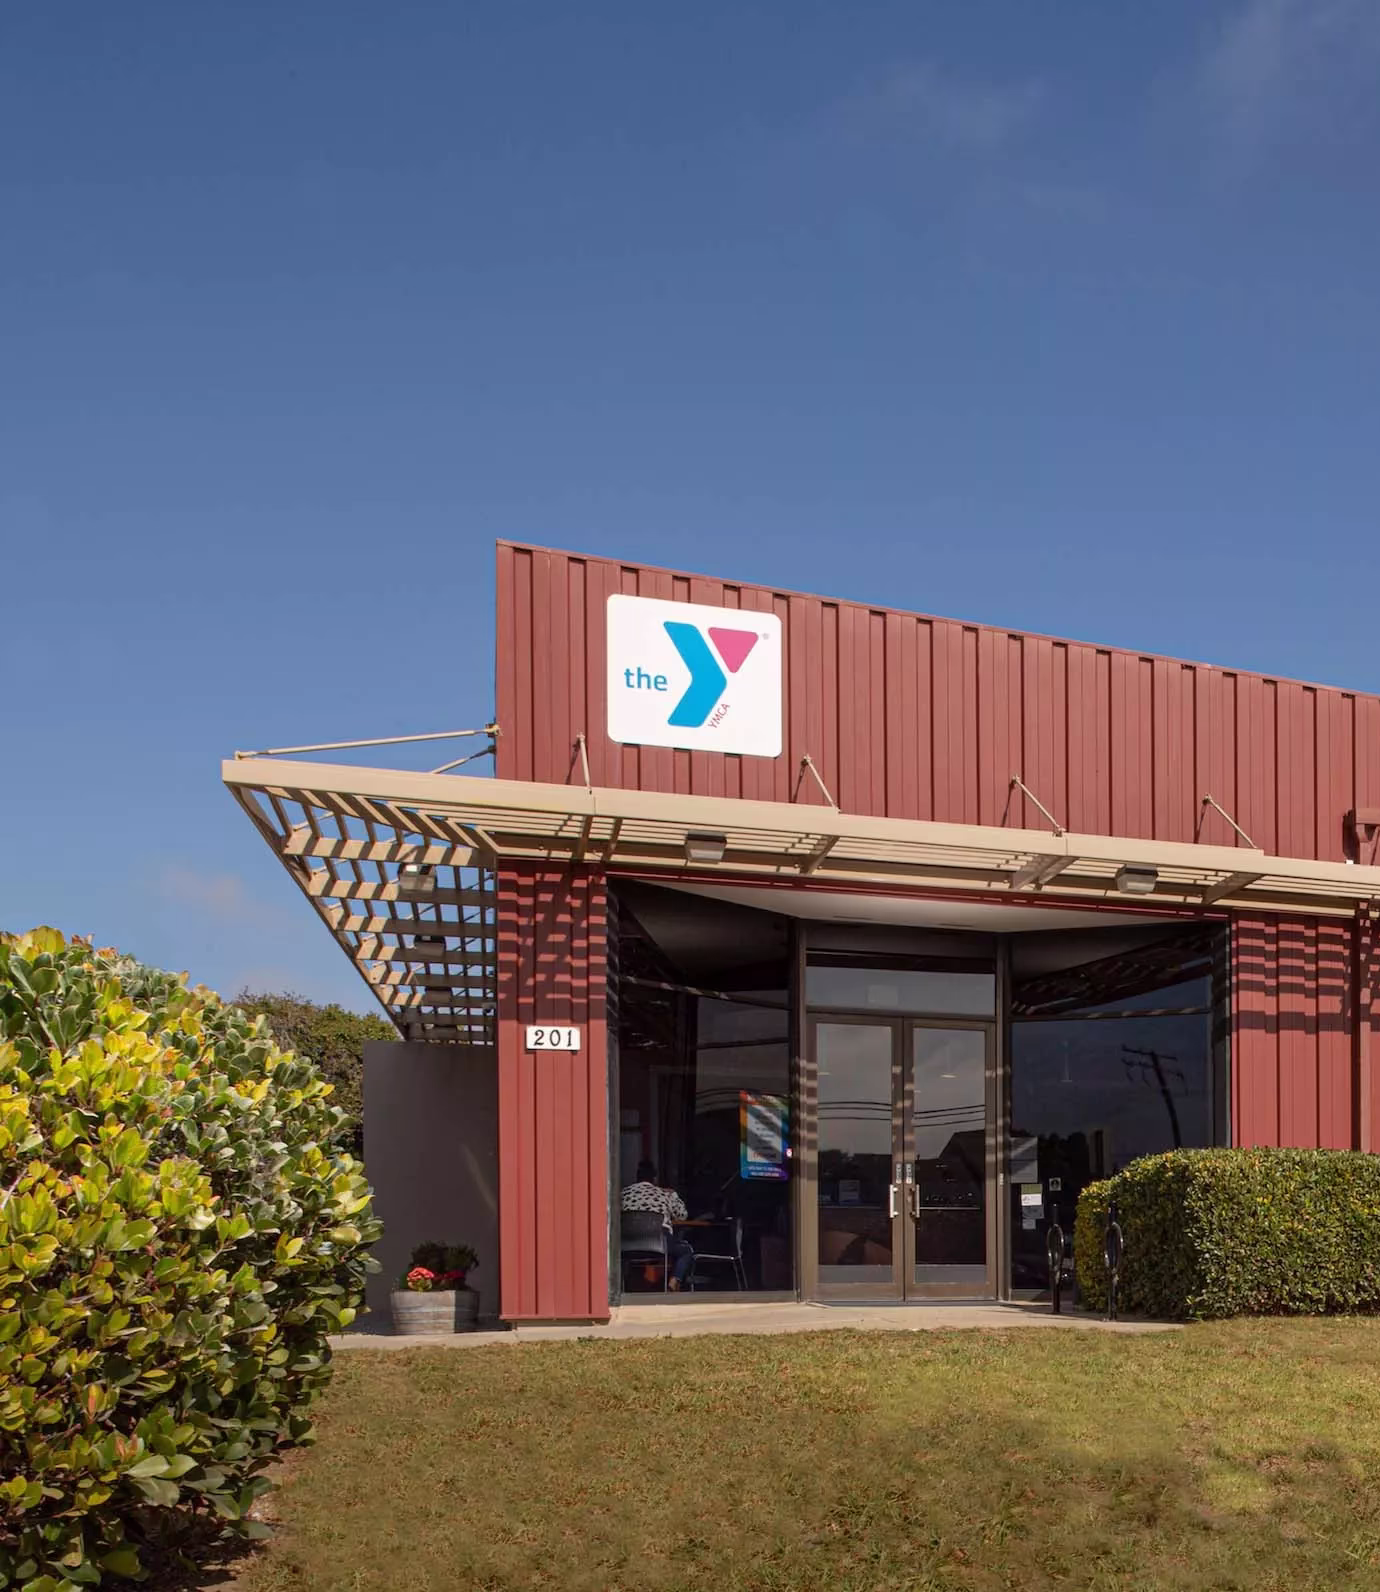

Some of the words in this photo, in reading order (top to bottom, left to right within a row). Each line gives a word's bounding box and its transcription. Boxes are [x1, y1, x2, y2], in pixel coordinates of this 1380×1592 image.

[624, 667, 668, 691] the
[708, 703, 731, 729] YMCA
[533, 1029, 573, 1047] 201
